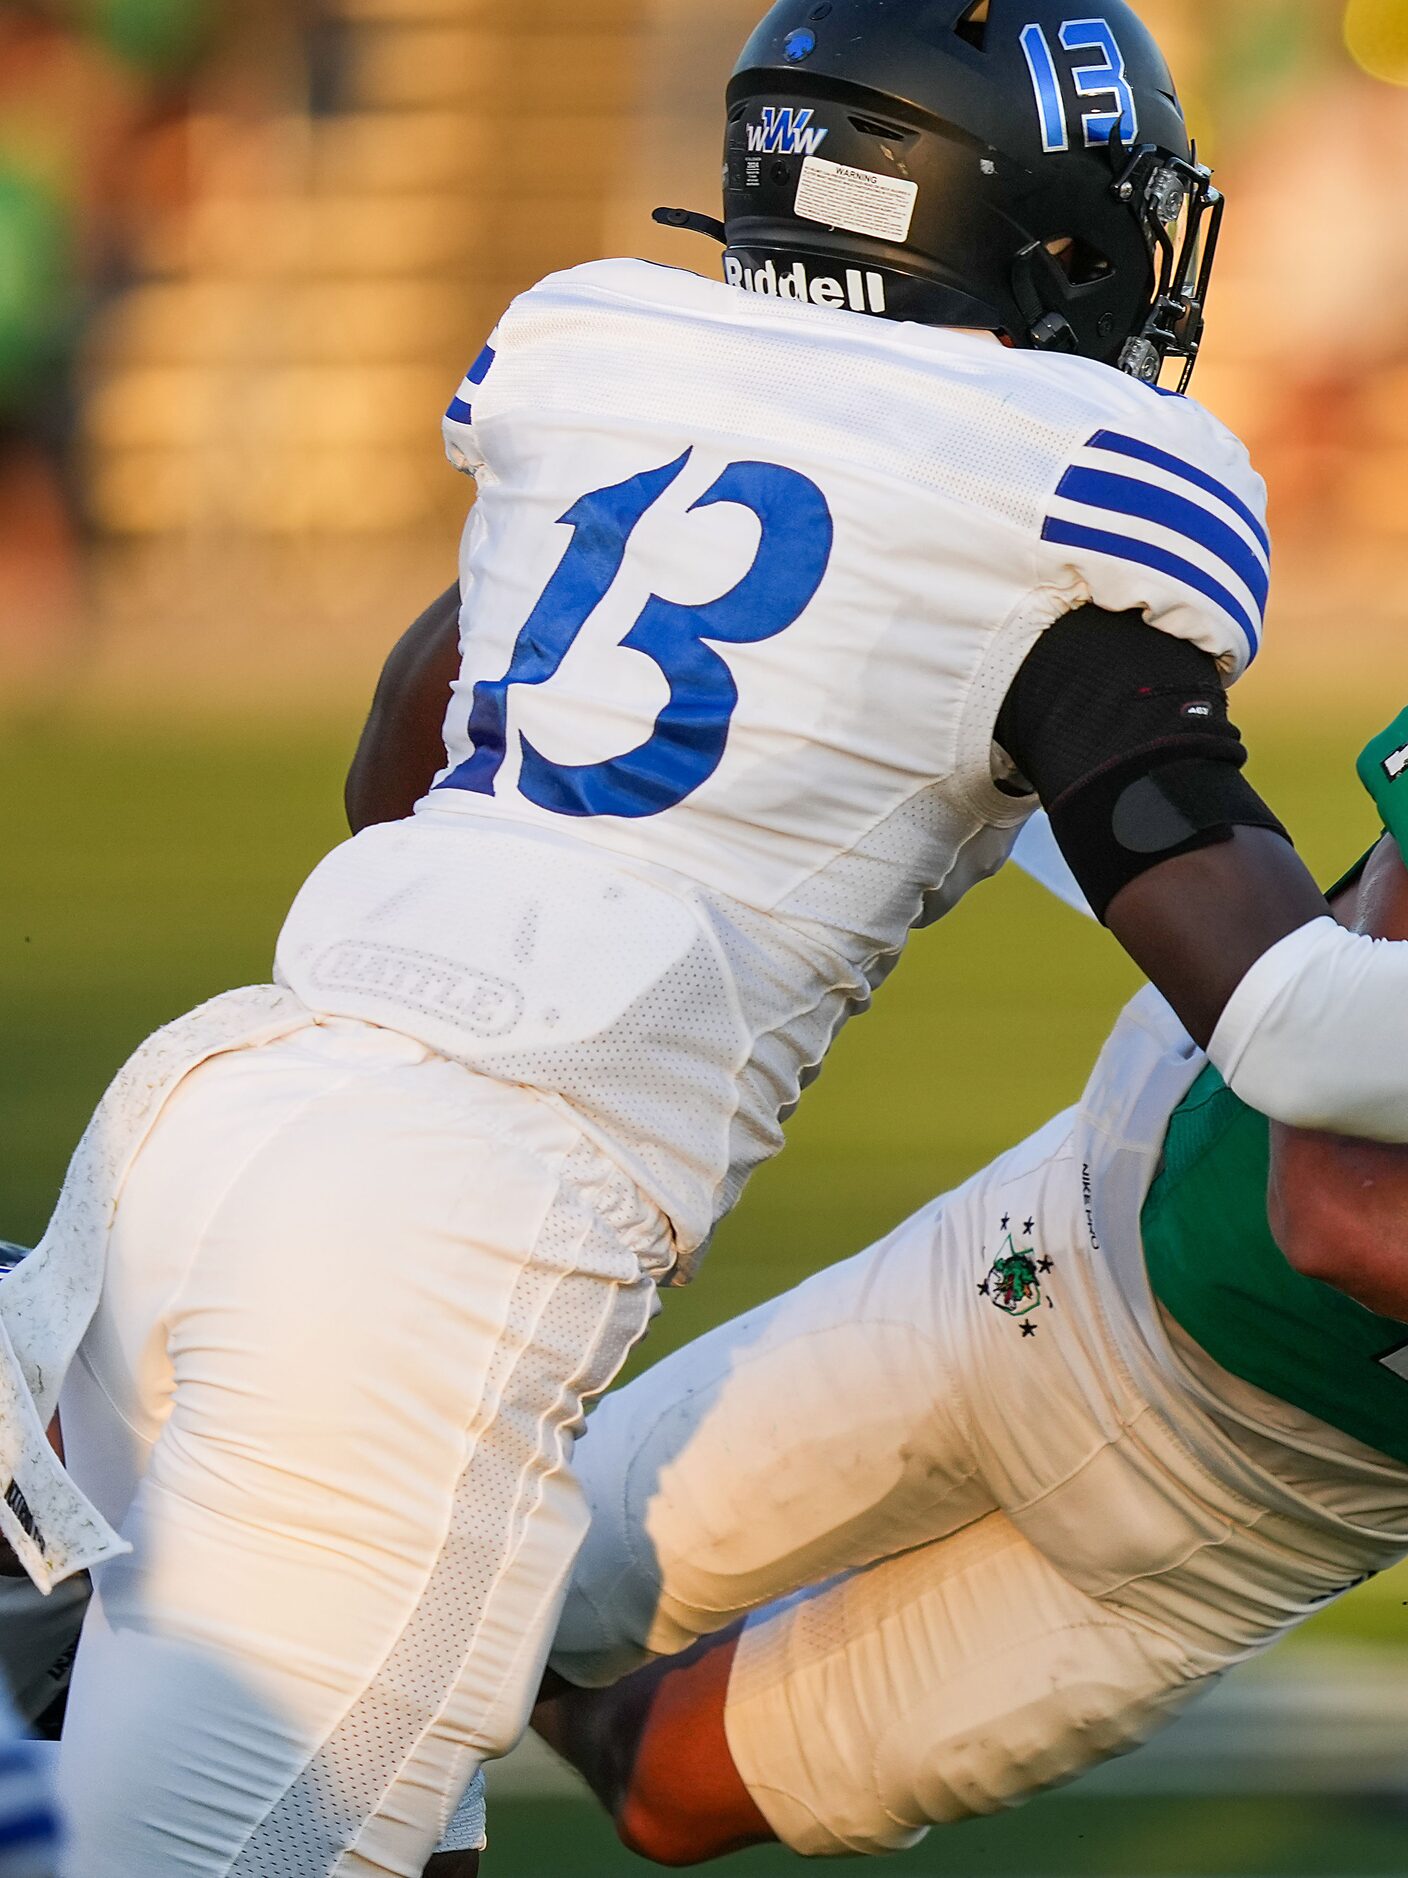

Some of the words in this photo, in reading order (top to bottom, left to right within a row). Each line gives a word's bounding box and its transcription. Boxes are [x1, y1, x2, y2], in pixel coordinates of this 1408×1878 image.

[1018, 17, 1138, 153] 13
[835, 167, 878, 184] WARNING
[724, 255, 886, 314] Riddell
[430, 444, 834, 819] 13
[1081, 1162, 1091, 1205] NIKE
